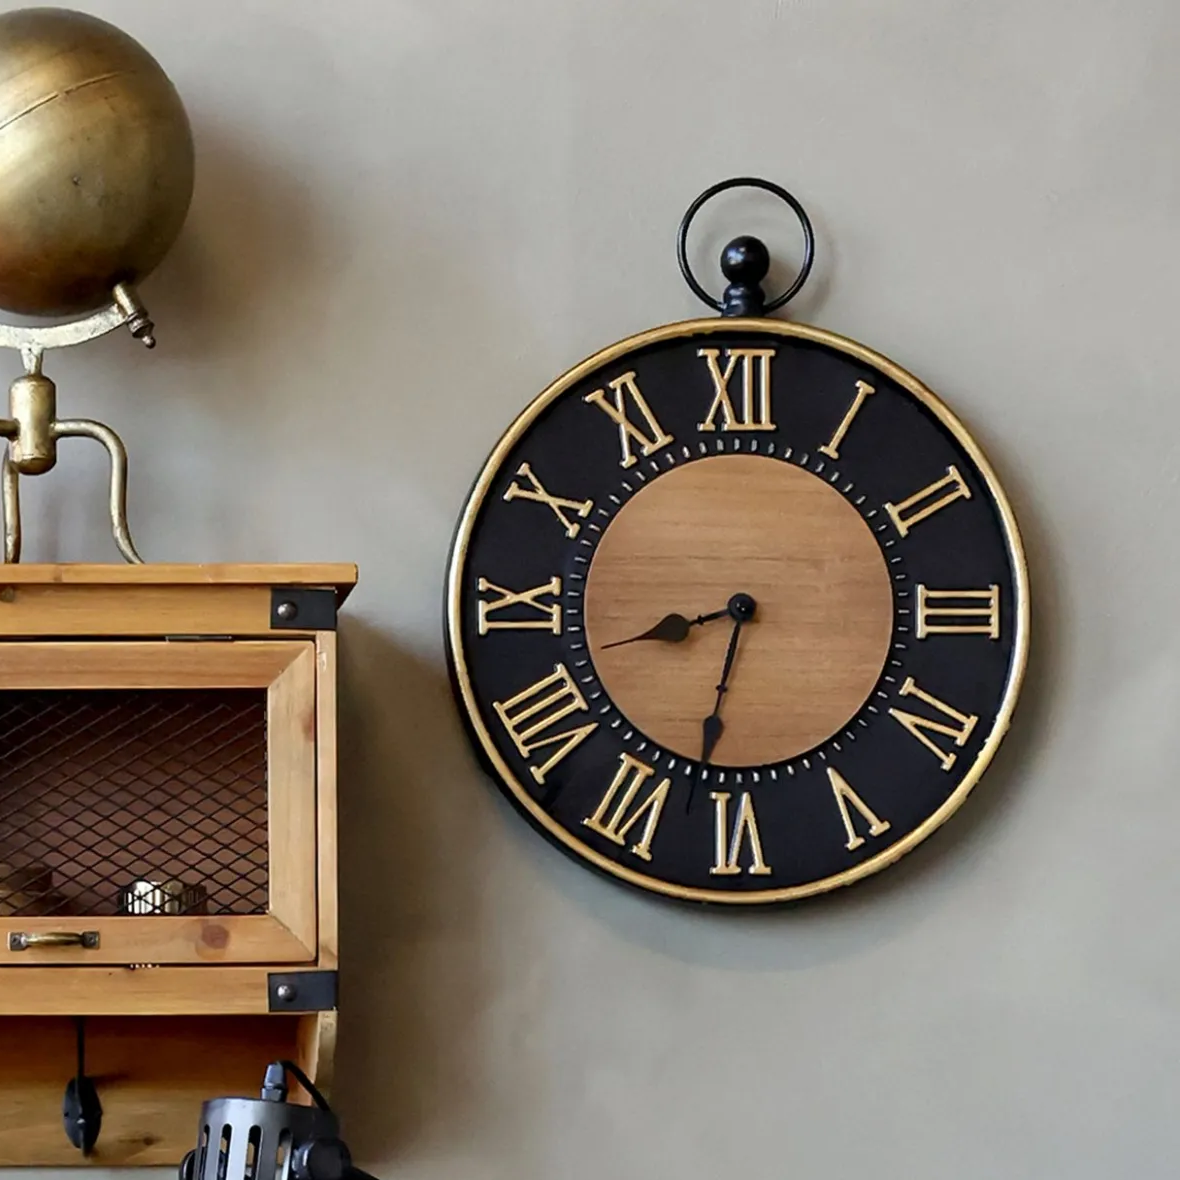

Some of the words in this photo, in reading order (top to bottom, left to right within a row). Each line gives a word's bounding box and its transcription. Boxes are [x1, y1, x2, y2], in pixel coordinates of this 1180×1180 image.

[584, 371, 674, 469] XI
[697, 348, 776, 432] XII
[820, 379, 876, 460] I
[503, 462, 593, 538] X
[885, 464, 972, 536] II
[477, 576, 562, 636] IX
[916, 584, 1000, 639] III
[492, 663, 599, 785] VIII
[888, 676, 979, 772] IV
[581, 751, 671, 861] VII
[709, 791, 772, 876] VI
[826, 766, 891, 851] V
